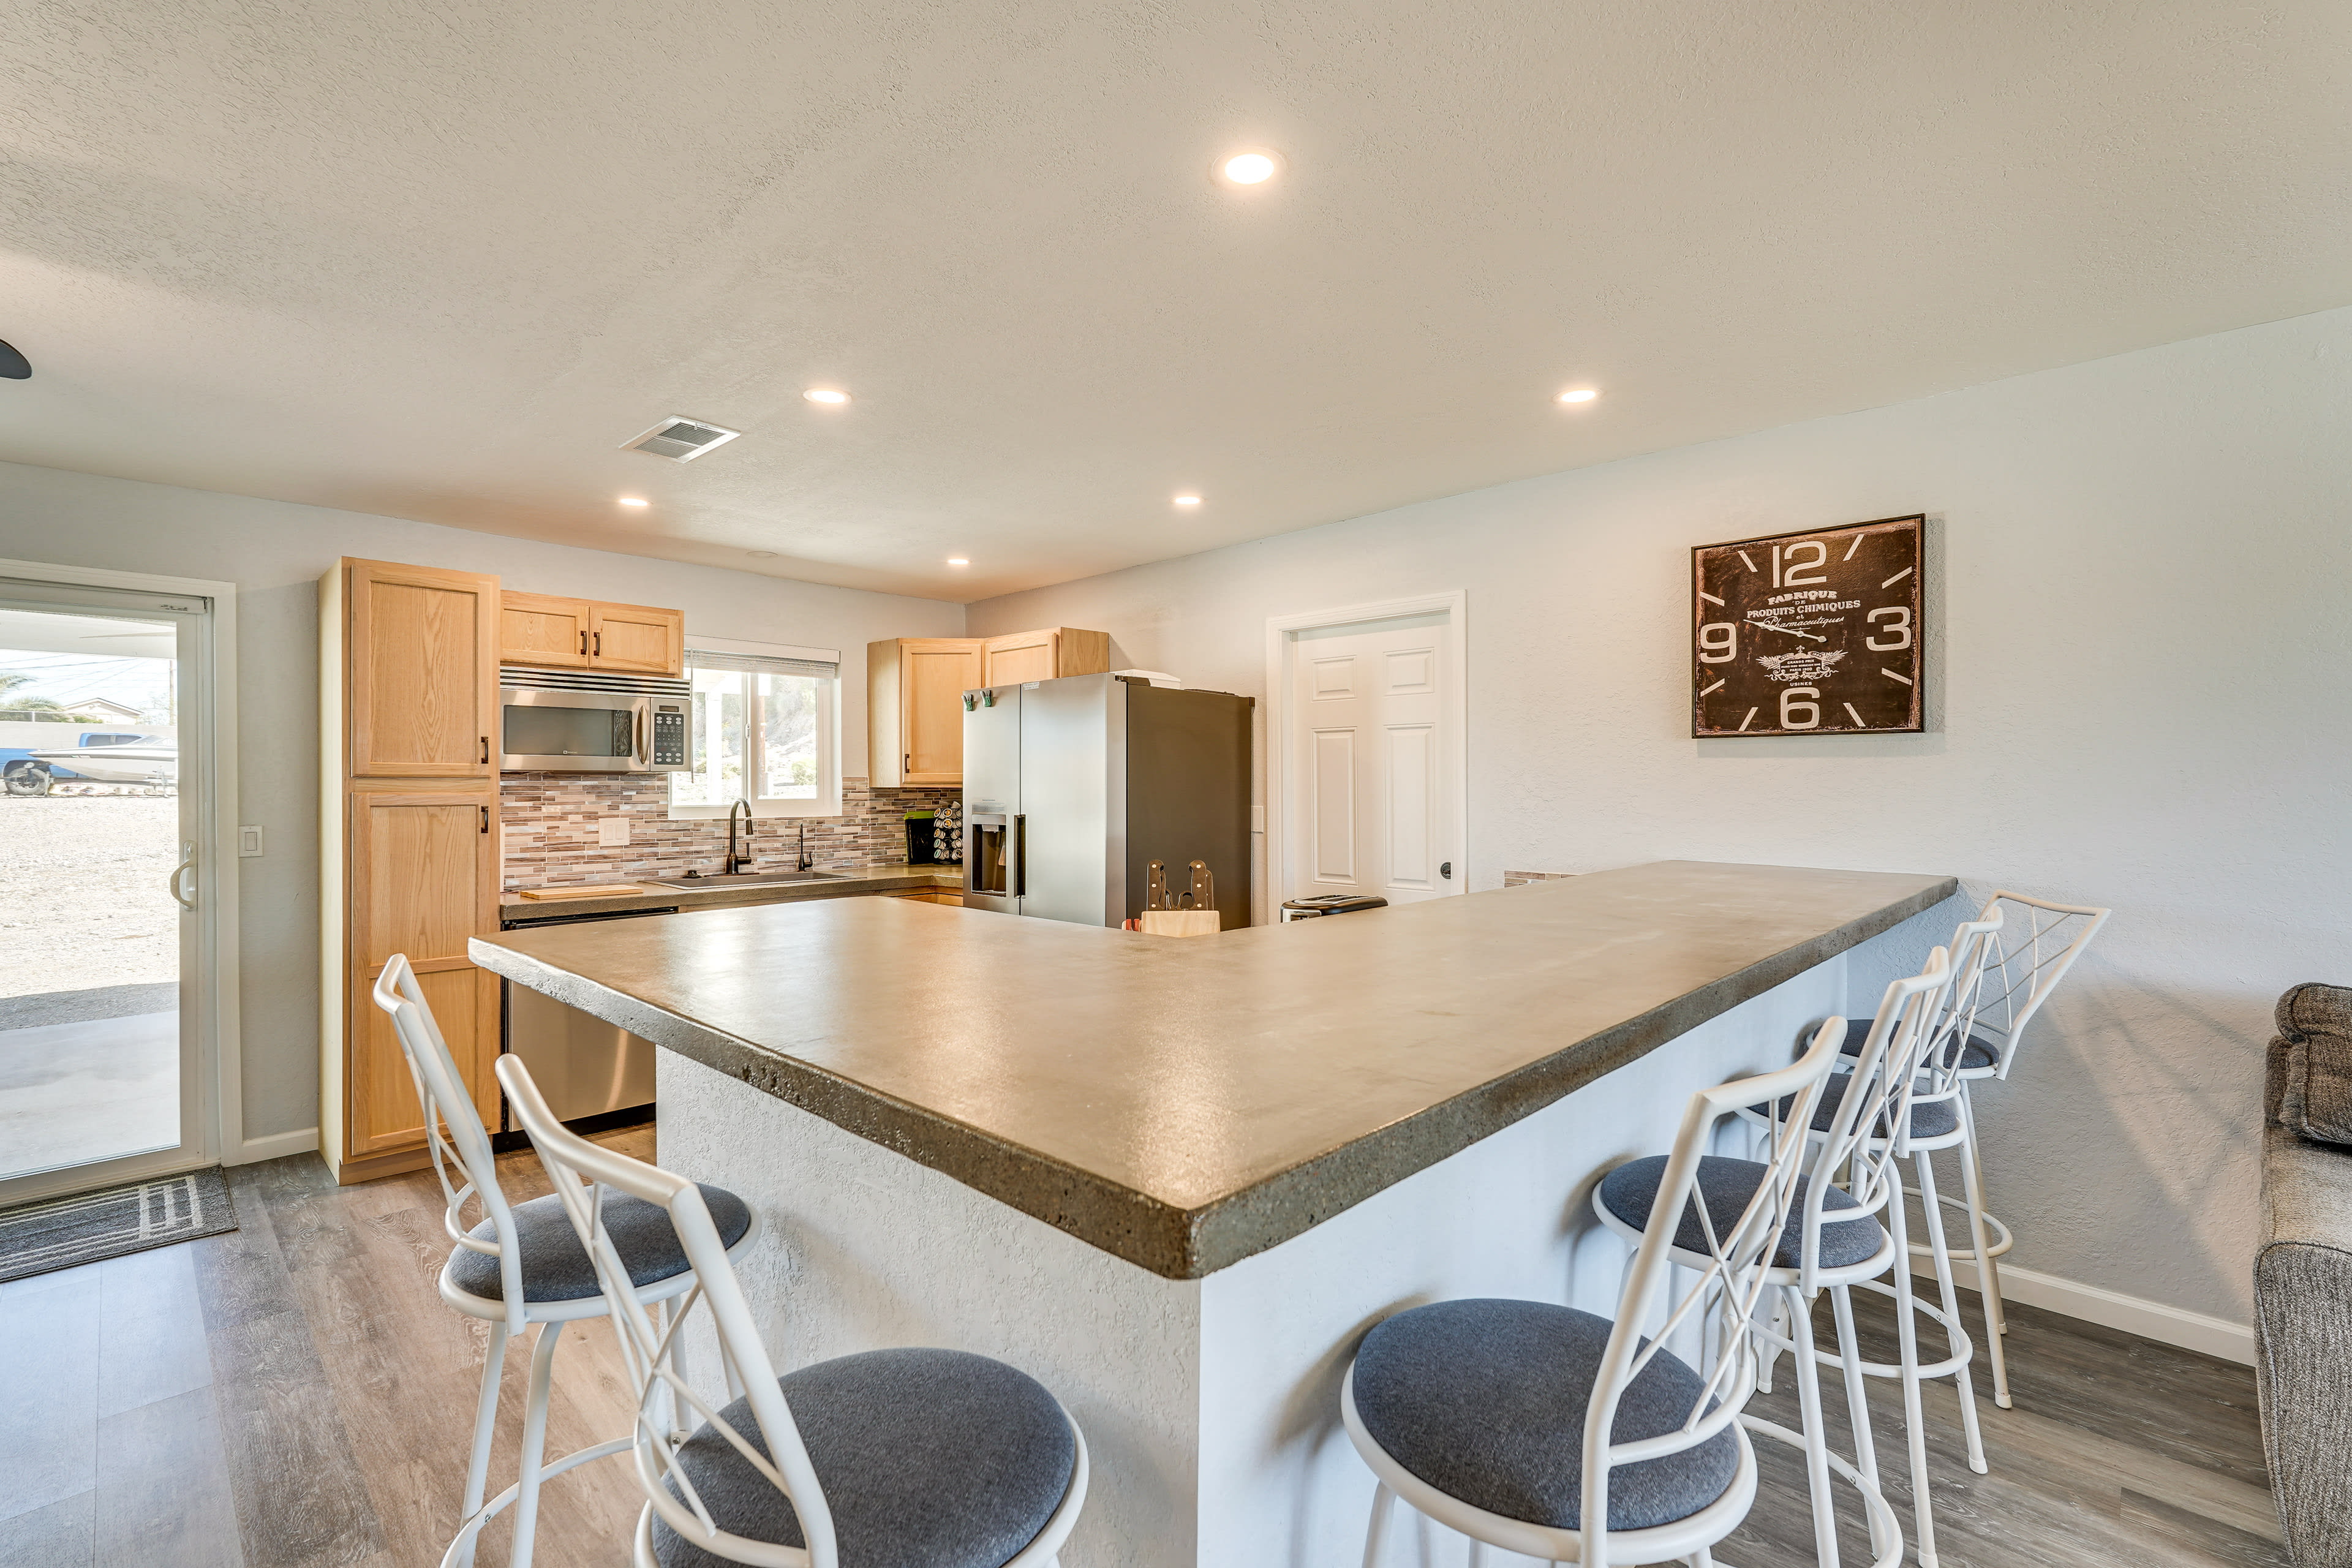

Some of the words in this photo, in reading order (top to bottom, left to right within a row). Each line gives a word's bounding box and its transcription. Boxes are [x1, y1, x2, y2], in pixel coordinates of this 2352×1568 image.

[1773, 541, 1827, 588] 12
[1747, 606, 1795, 619] PRODUITS
[1797, 600, 1861, 613] CHIMIQUES
[1768, 590, 1838, 605] FABRIQUE
[1699, 622, 1737, 663] 9
[1763, 616, 1845, 628] Pharmaceutiques
[1866, 606, 1912, 652] 3
[1780, 687, 1820, 729] 6
